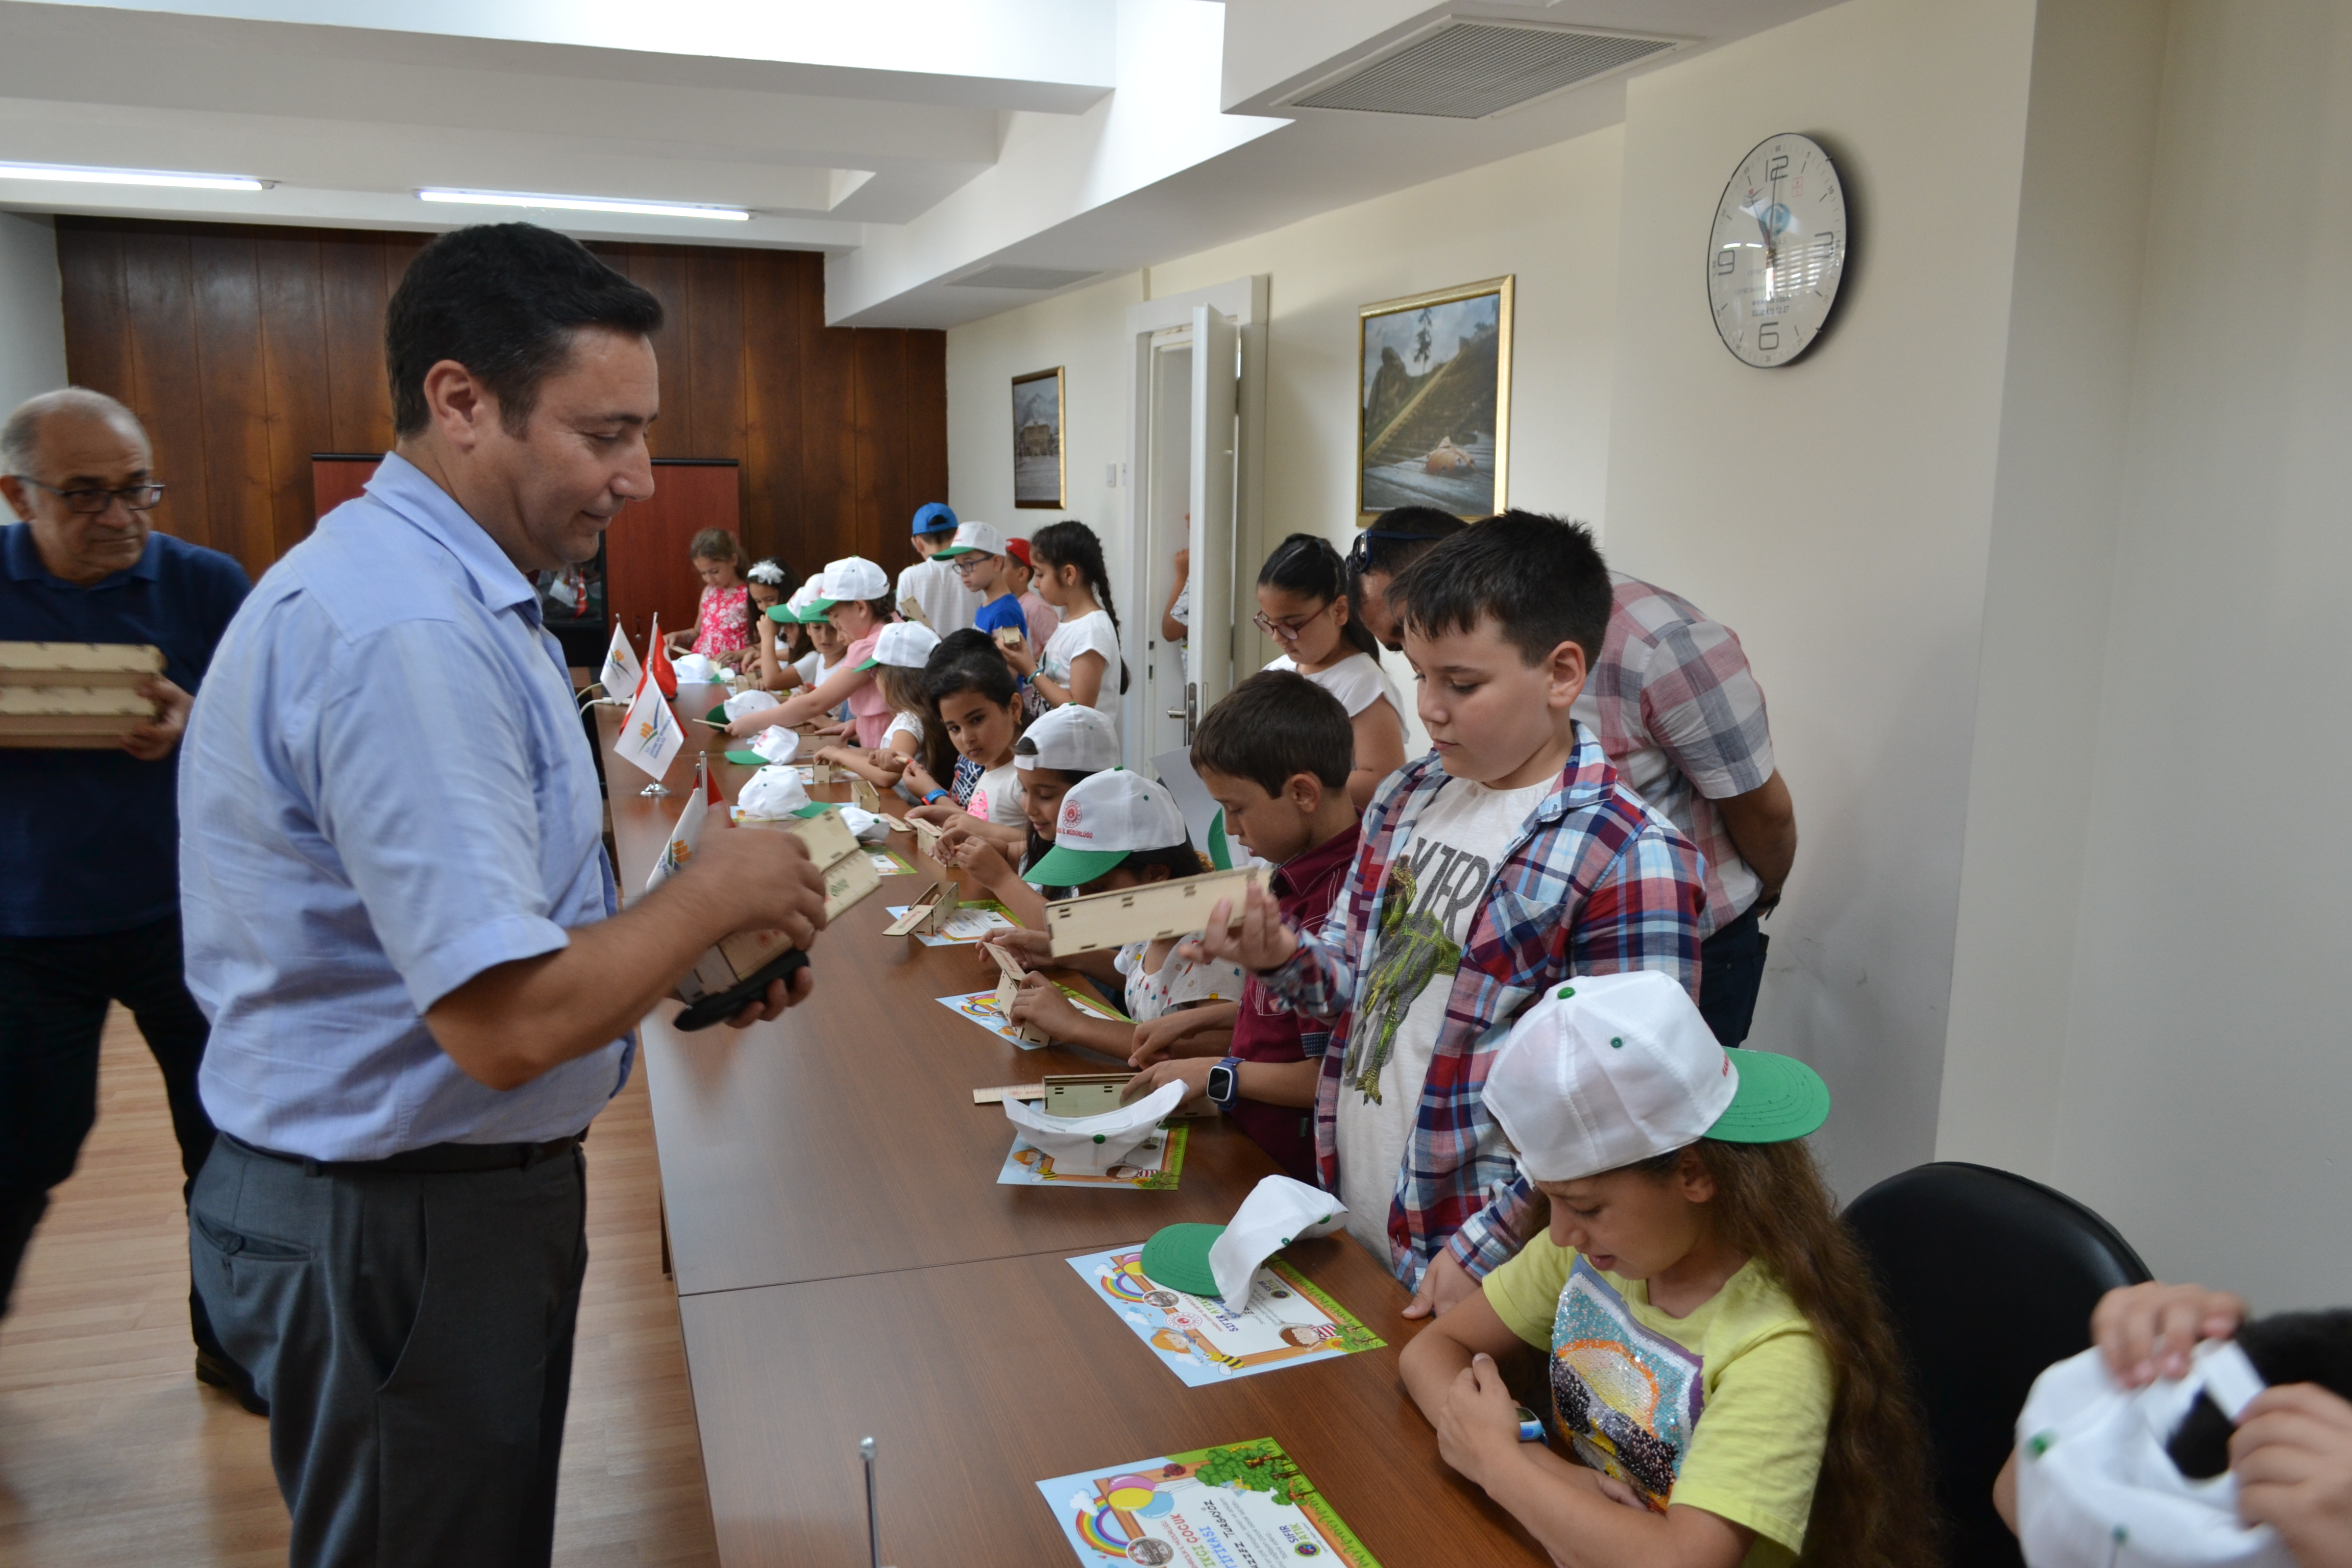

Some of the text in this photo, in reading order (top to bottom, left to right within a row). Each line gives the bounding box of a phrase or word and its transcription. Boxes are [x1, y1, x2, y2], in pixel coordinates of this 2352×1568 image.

[1765, 155, 1788, 182] 12
[1718, 250, 1735, 276] 9
[1759, 322, 1779, 351] 6
[1257, 1280, 1273, 1291] SIFIR
[1215, 1314, 1238, 1332] SIFIR
[1170, 1513, 1199, 1543] ÇOCUK
[1279, 1525, 1298, 1543] SIFIR
[1289, 1523, 1309, 1539] ATIK
